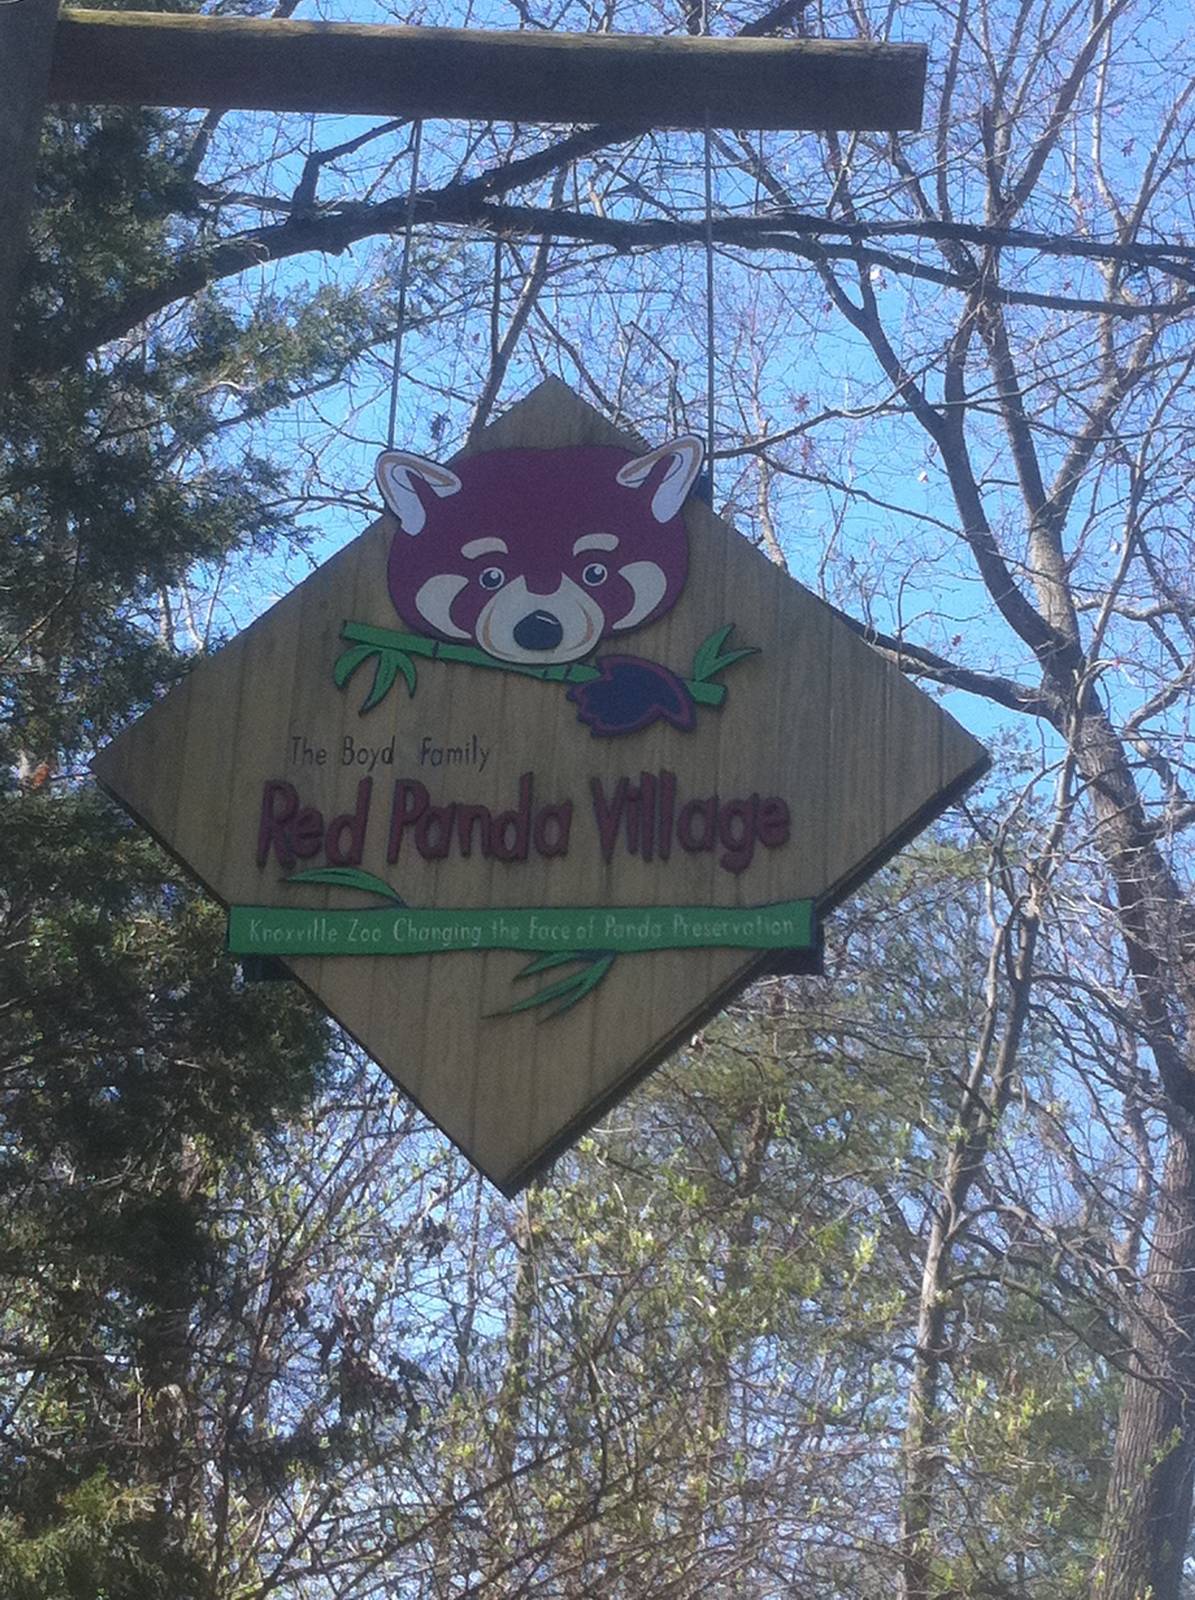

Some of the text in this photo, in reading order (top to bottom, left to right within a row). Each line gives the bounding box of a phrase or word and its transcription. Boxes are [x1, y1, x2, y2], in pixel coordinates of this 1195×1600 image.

[291, 734, 490, 772] The Boyd Family
[258, 768, 791, 874] Red Panda Village
[249, 913, 793, 946] Knoxville Zoo Changing the Face of Panda Preservation
